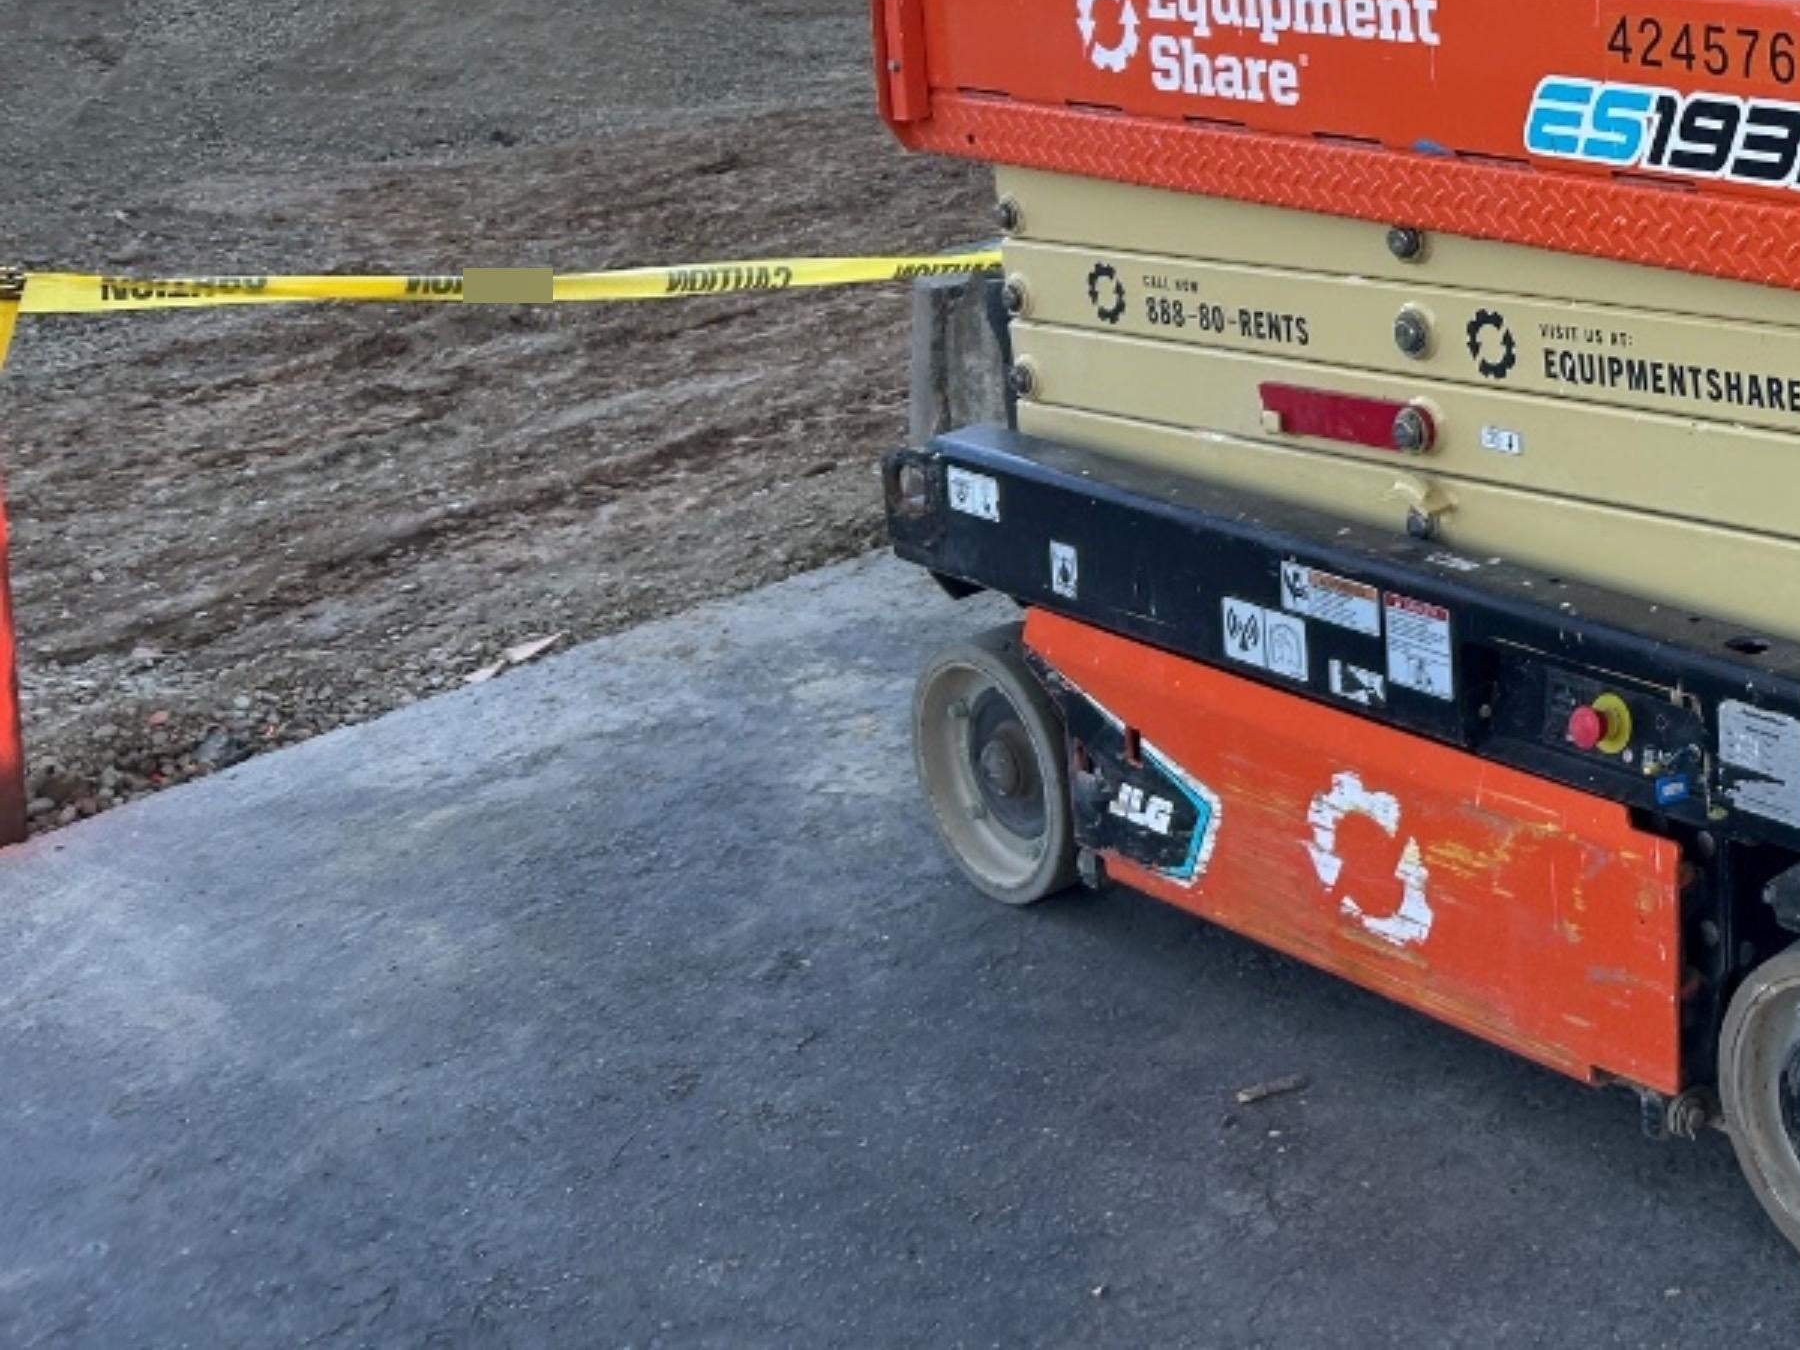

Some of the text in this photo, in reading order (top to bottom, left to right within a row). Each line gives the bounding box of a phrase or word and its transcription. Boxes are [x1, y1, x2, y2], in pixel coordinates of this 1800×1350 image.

[1150, 34, 1300, 106] Share
[1607, 14, 1796, 84] 424576
[1145, 296, 1309, 346] 888-80-RENTS
[1539, 323, 1578, 341] VISIT
[1585, 328, 1603, 344] US
[1109, 782, 1173, 834] JLG
